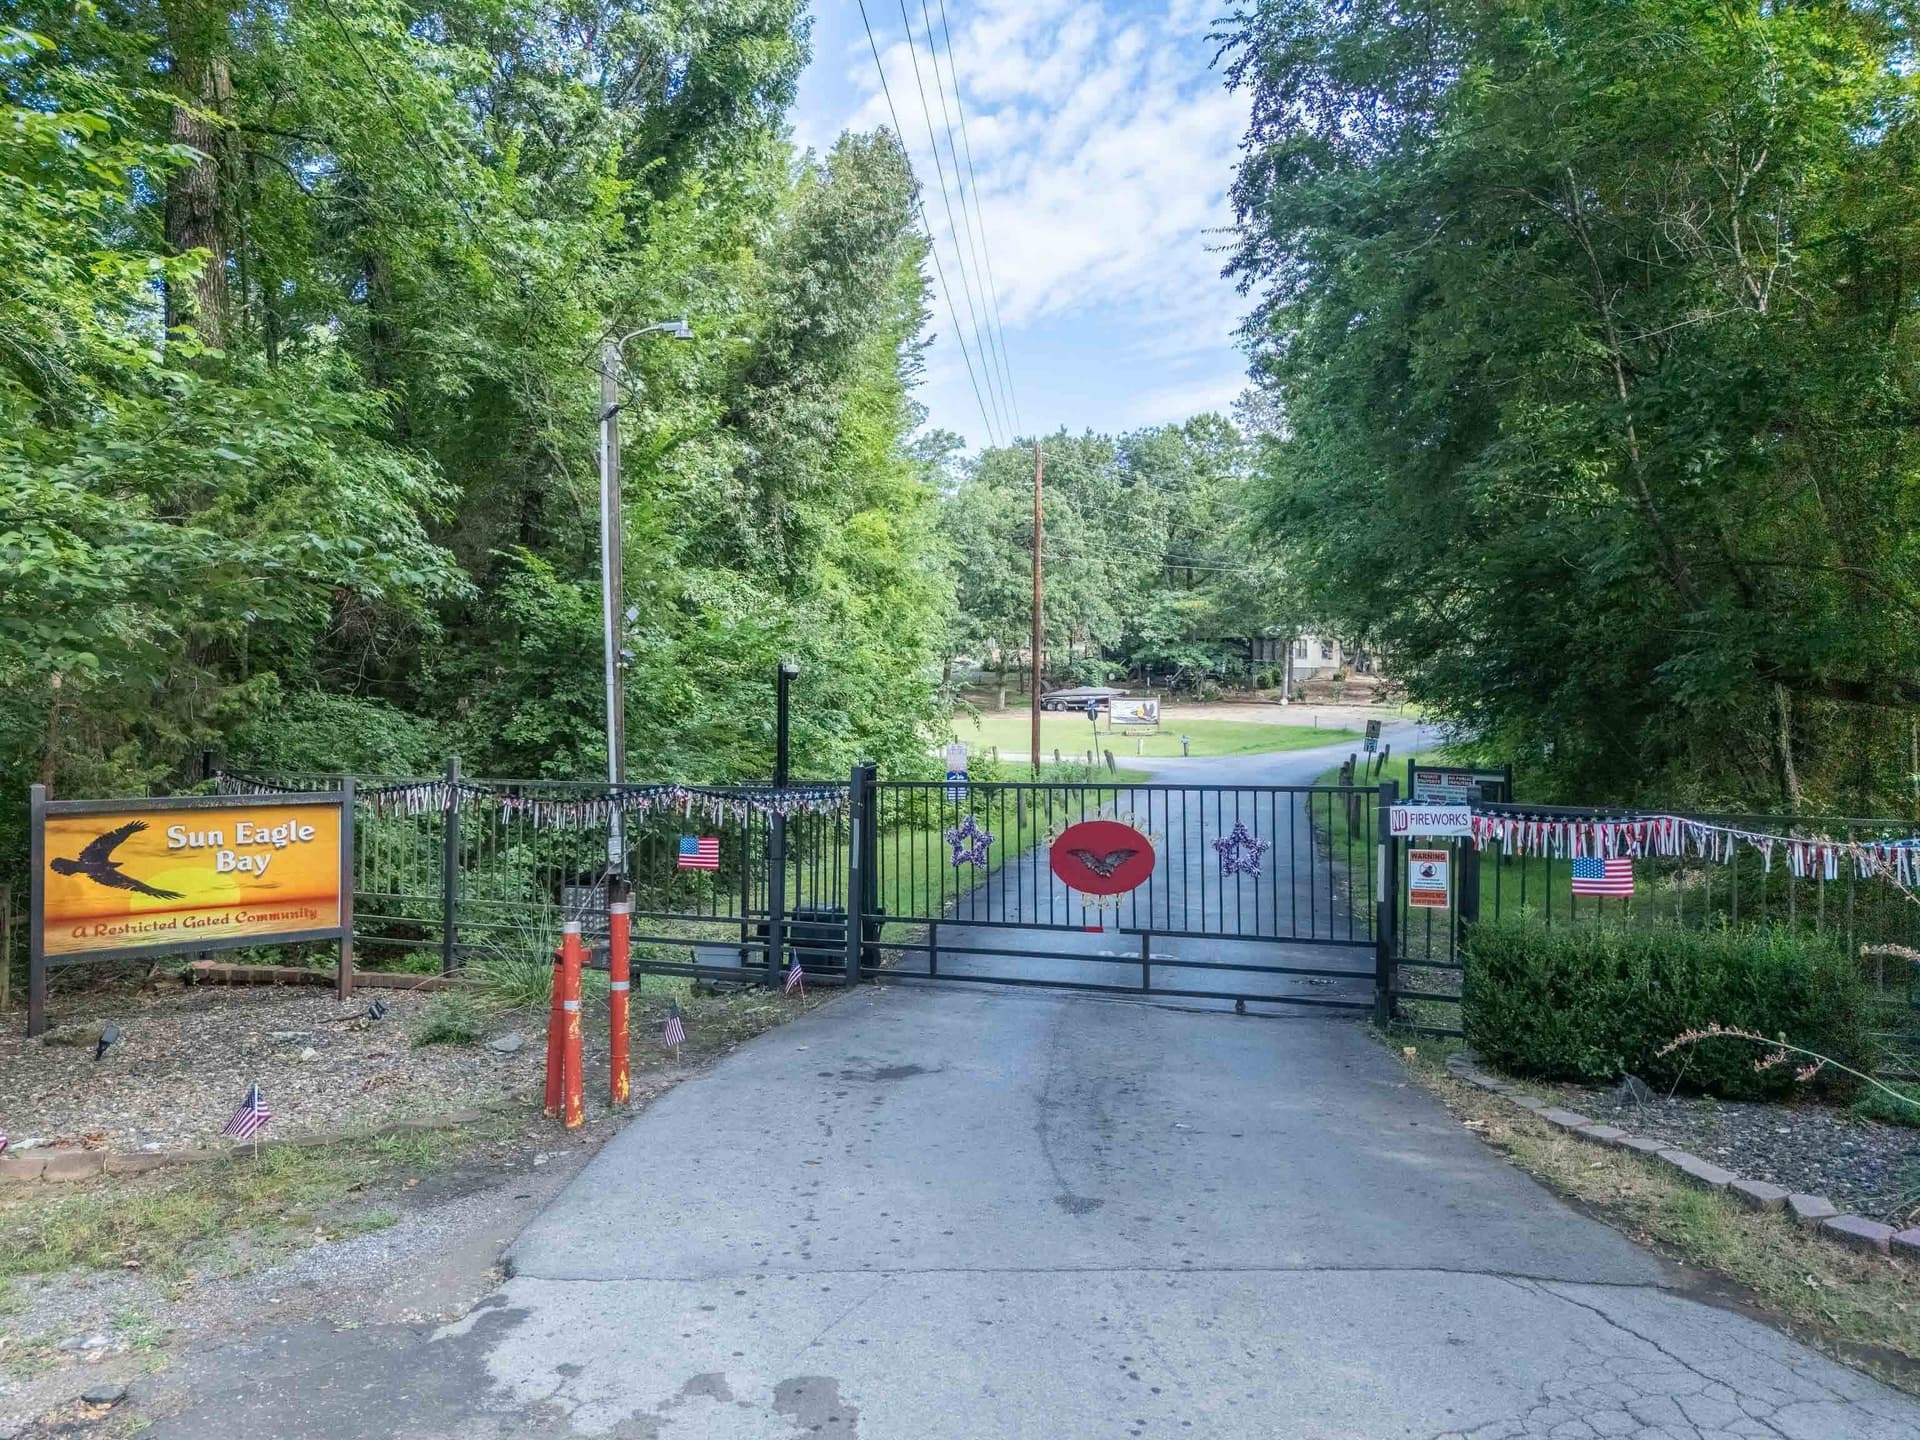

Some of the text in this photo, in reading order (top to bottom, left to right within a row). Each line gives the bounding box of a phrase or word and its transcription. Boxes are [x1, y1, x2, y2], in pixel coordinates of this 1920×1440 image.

[1392, 809, 1468, 831] NO FIREWORKS
[167, 820, 315, 849] Sun Eagle
[216, 850, 271, 877] Bay
[1411, 852, 1446, 861] WARNING
[72, 908, 317, 938] A Restricted Gated Community
